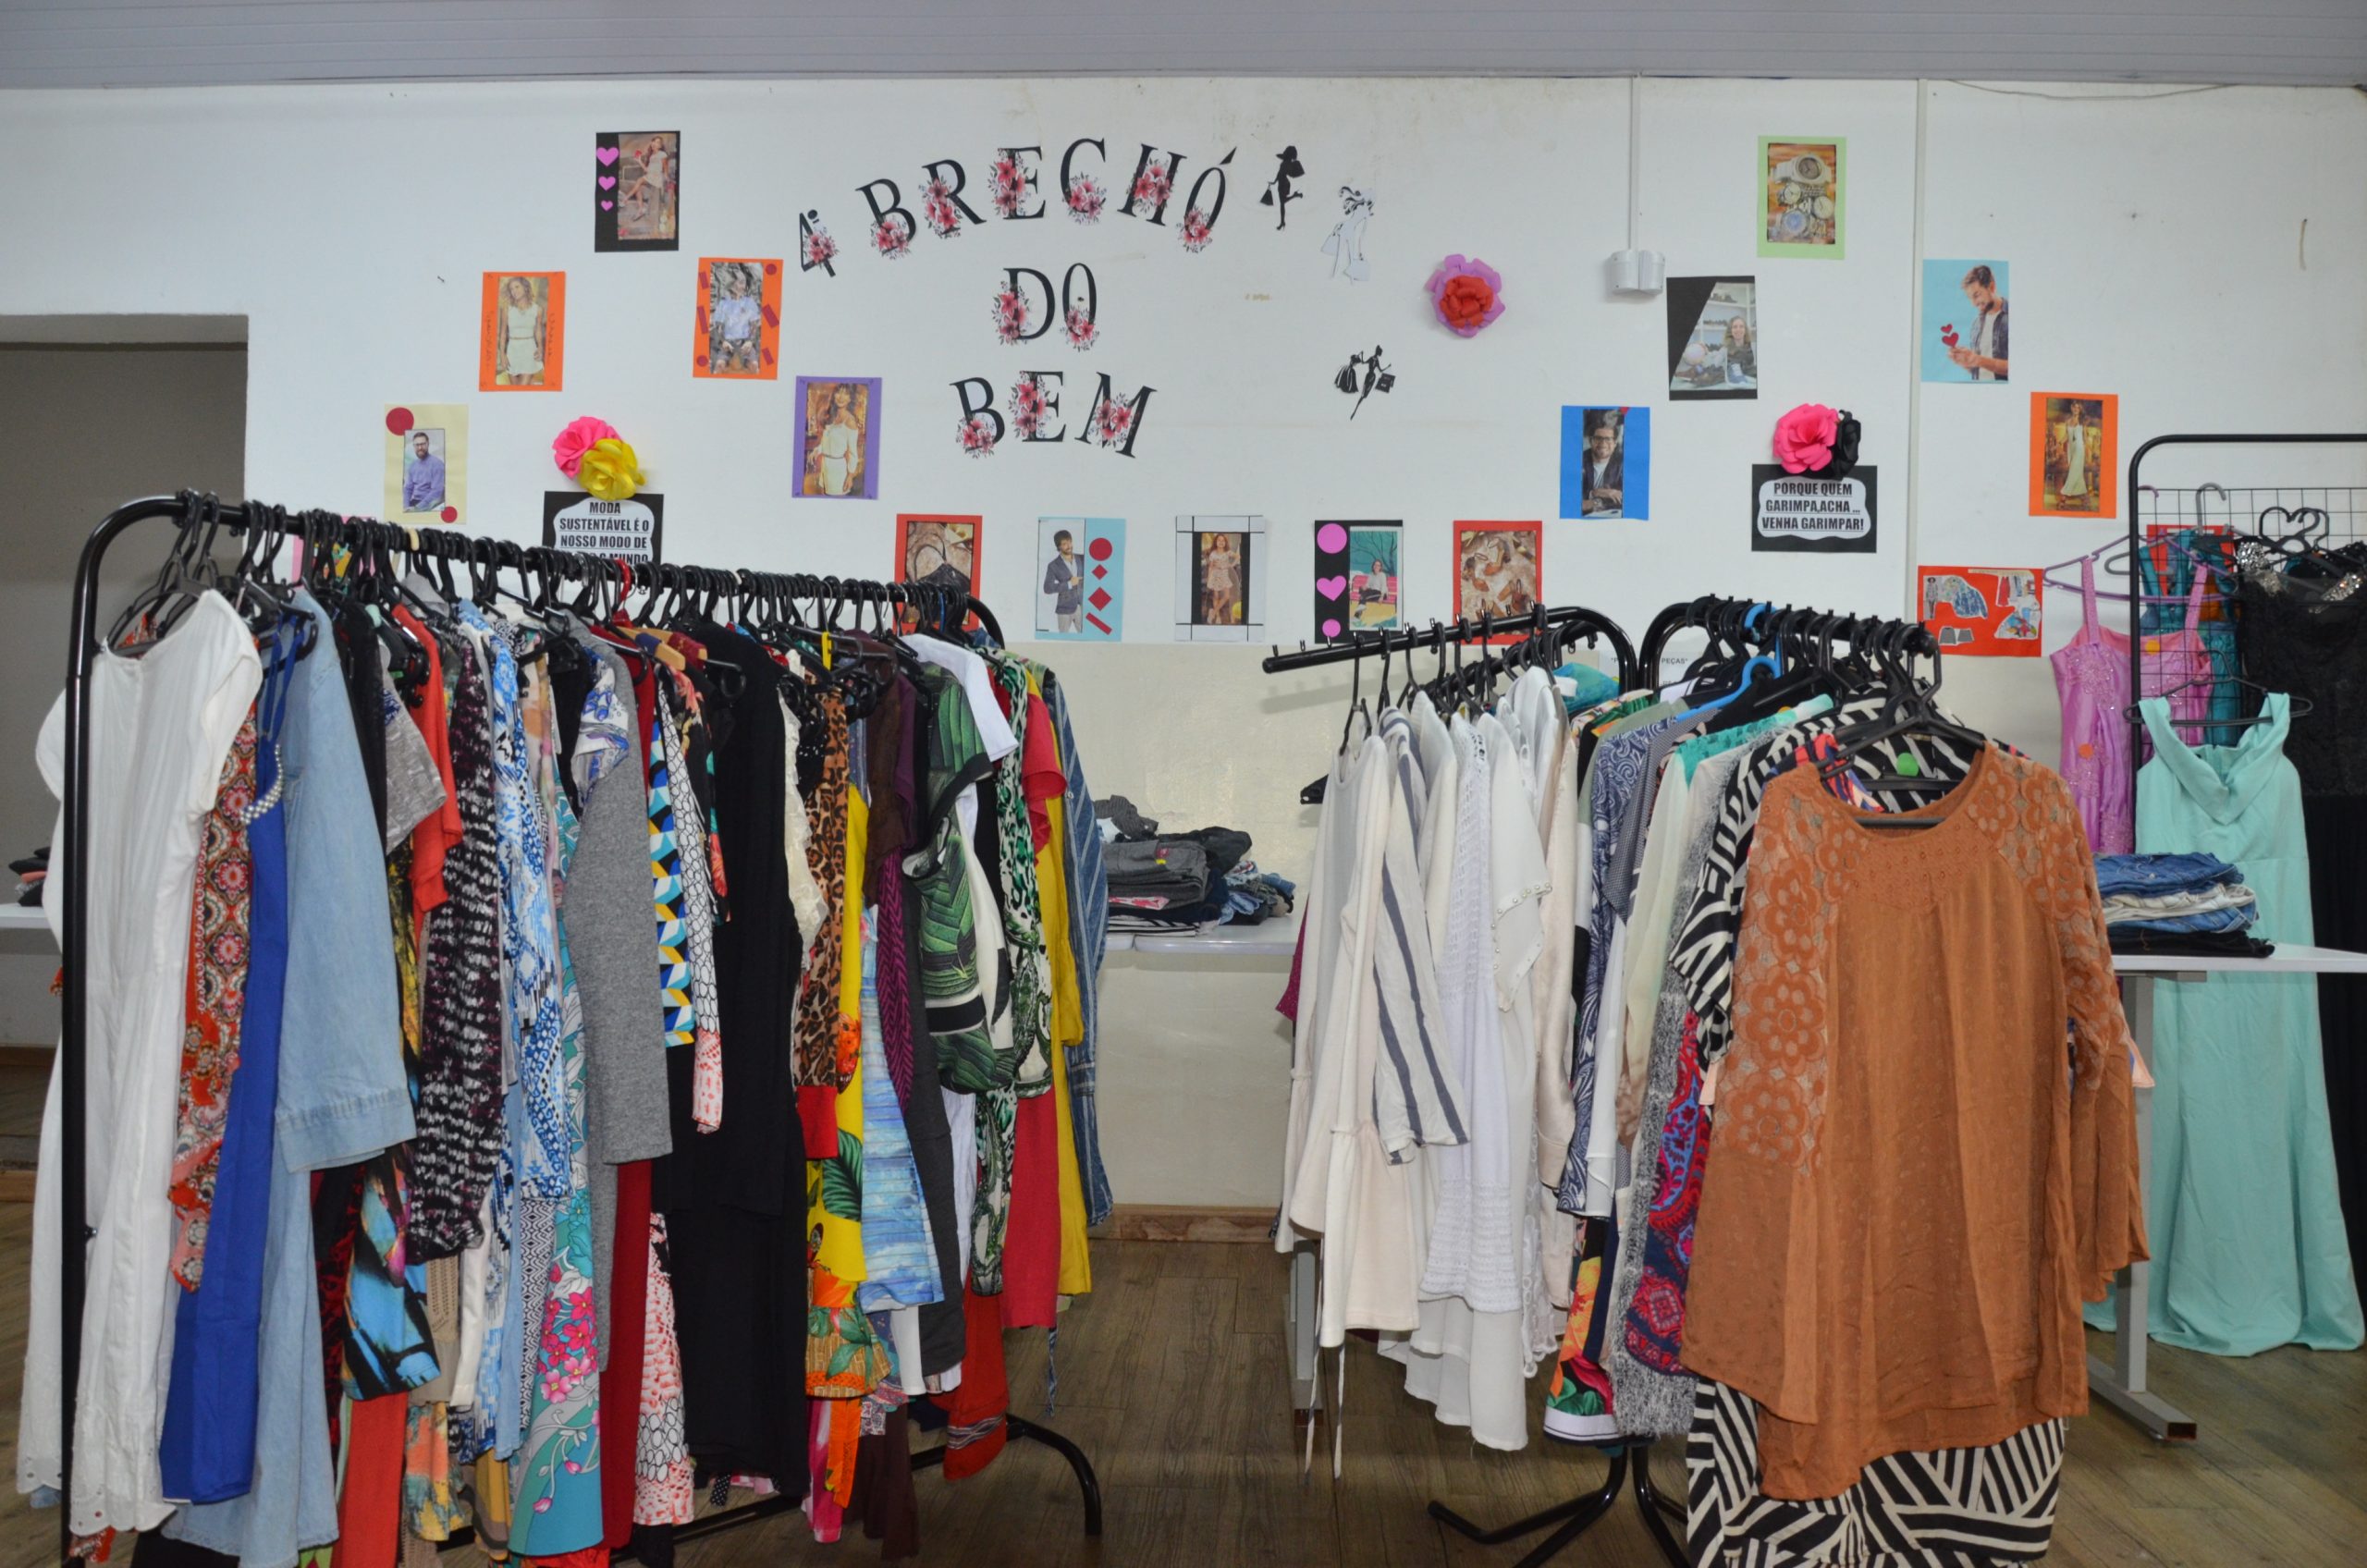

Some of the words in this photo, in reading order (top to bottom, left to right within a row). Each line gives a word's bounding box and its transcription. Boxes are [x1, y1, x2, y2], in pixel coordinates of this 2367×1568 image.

[855, 138, 1237, 254] BRECHÓ
[991, 263, 1099, 350] DO
[949, 371, 1158, 459] BEM
[1773, 483, 1819, 496] PORQUE
[1821, 484, 1853, 496] QUEM
[589, 501, 621, 514] MODA
[559, 518, 631, 532] SUSTENTÁVEL
[633, 518, 640, 532] É
[642, 520, 649, 532] O
[1761, 517, 1799, 530] VENHA
[1801, 518, 1865, 531] GARIMPAR!
[560, 535, 596, 547] NOSSO
[599, 536, 631, 548] MODO
[633, 537, 647, 549] DE
